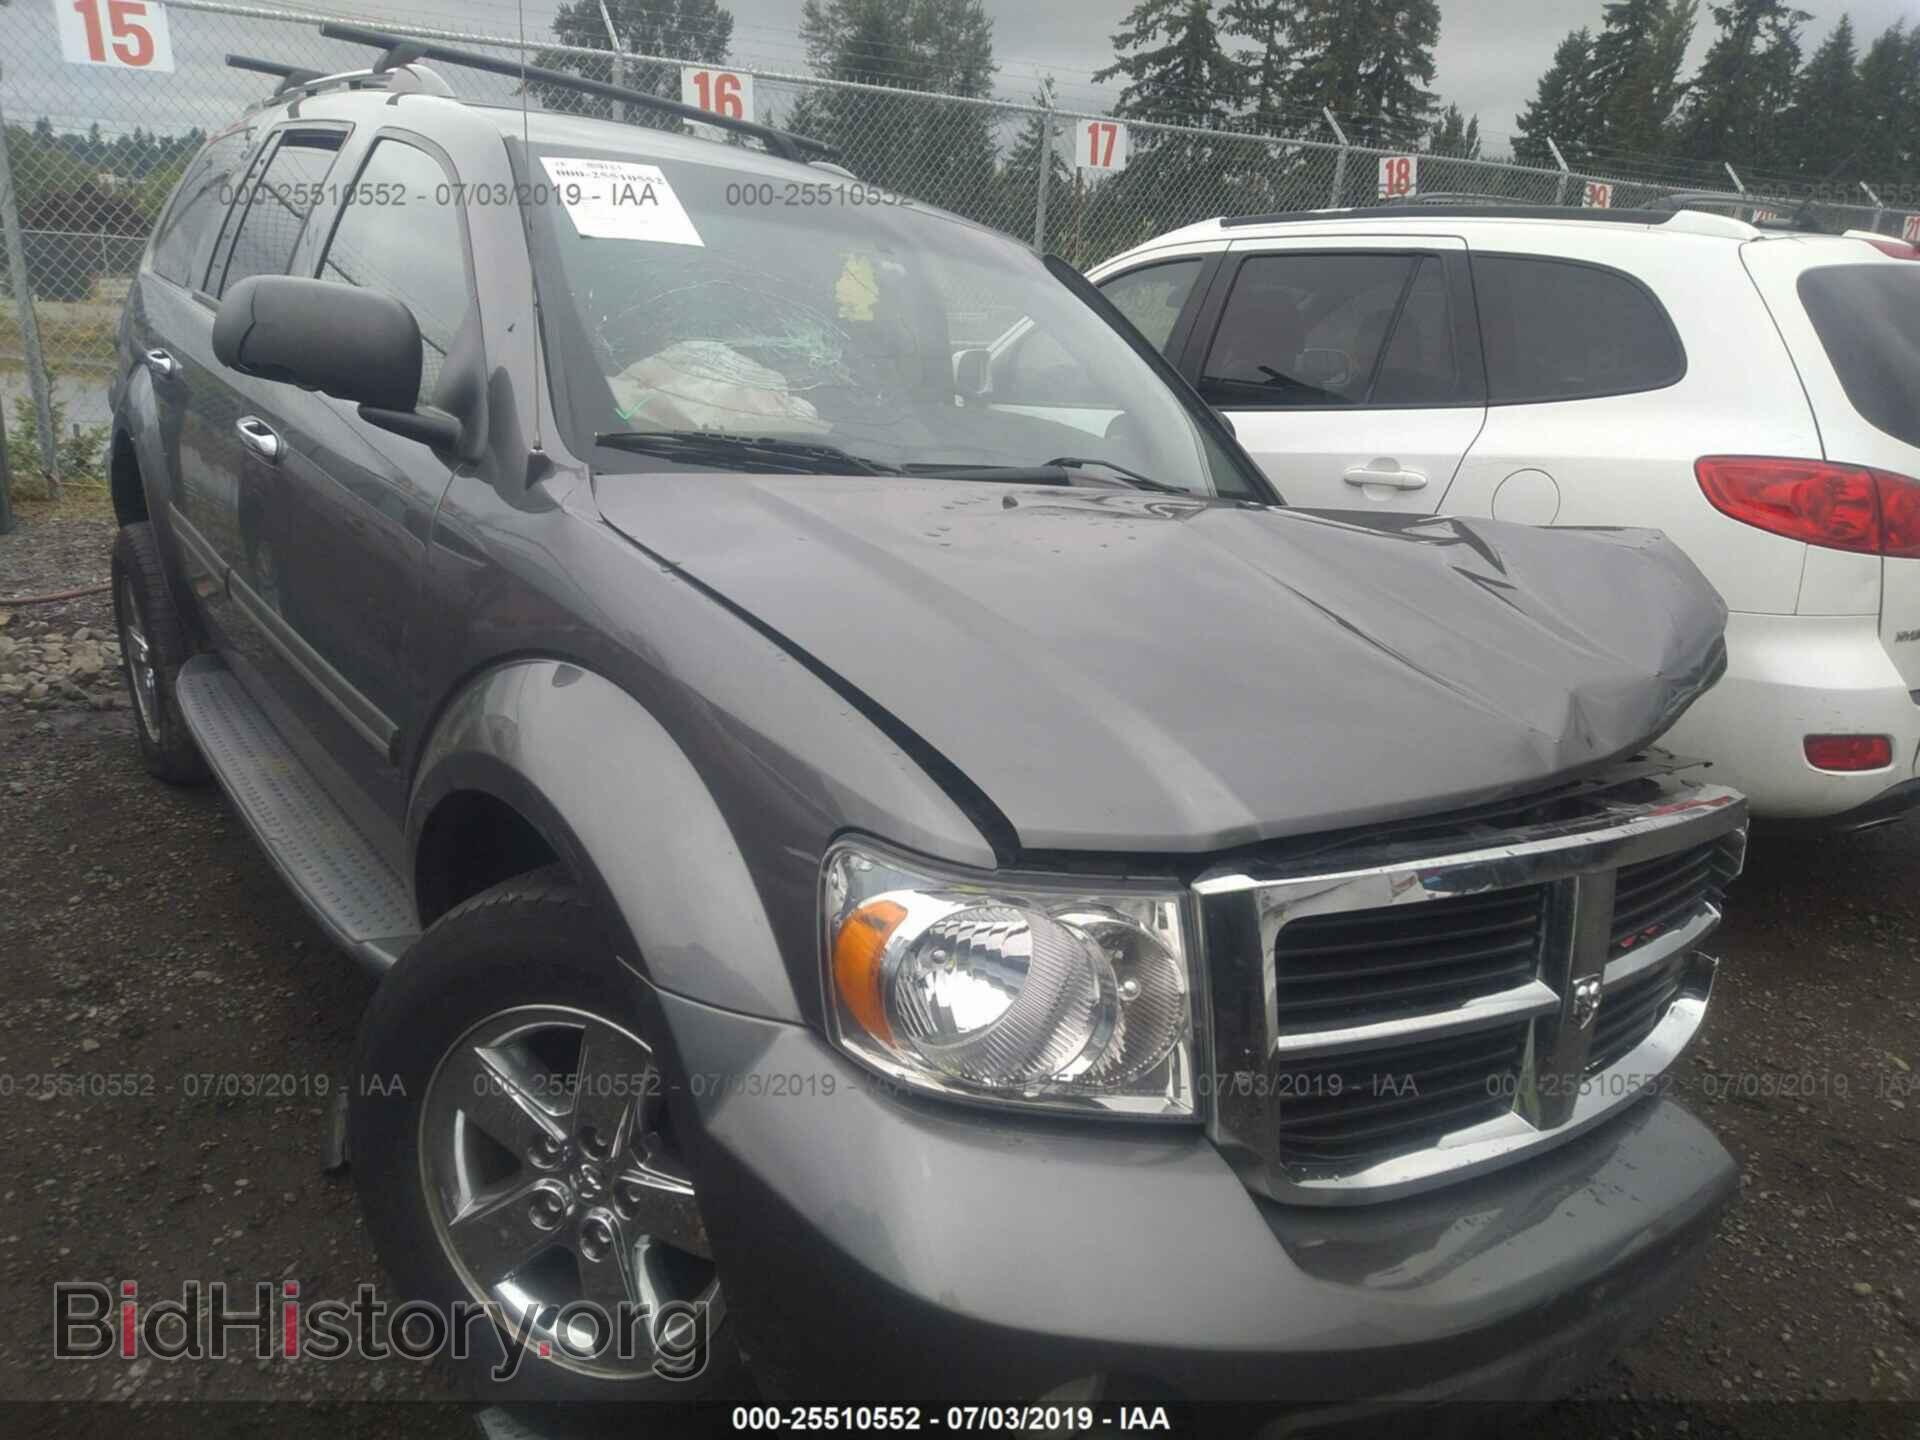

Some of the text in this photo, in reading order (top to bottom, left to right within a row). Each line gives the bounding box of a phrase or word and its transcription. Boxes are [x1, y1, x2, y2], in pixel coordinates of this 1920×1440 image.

[73, 0, 155, 66] 15
[694, 71, 743, 120] 16
[1087, 122, 1118, 167] 17
[1385, 158, 1411, 194] 18
